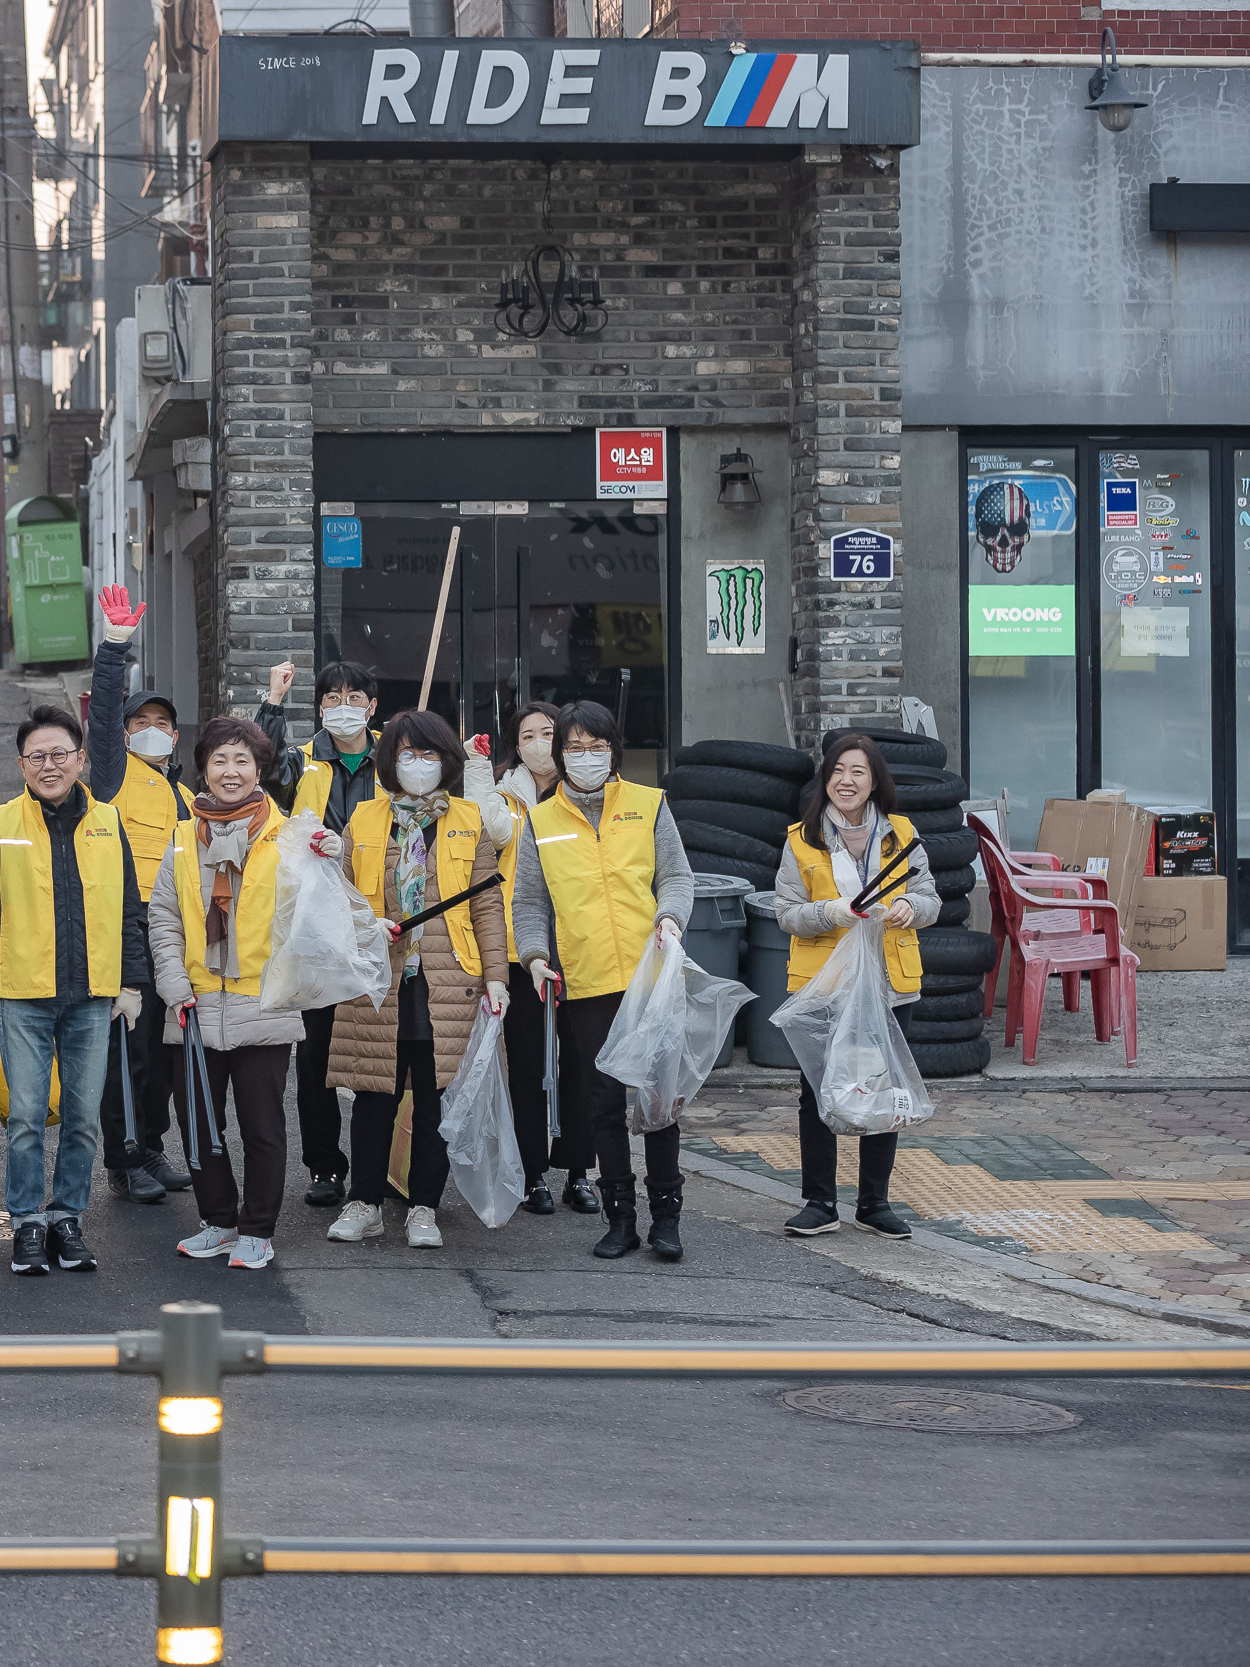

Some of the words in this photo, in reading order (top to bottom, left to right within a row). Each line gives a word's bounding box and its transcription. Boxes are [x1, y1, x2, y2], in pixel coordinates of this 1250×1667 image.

[258, 57, 296, 70] SINCE
[300, 55, 321, 67] 2018
[362, 48, 601, 125] RIDE
[610, 447, 654, 466] 에스원
[979, 461, 1023, 472] DAVIDSON
[600, 485, 636, 495] SECOM
[326, 522, 358, 533] CESCO
[849, 554, 875, 574] 76
[981, 607, 1062, 622] VROONG
